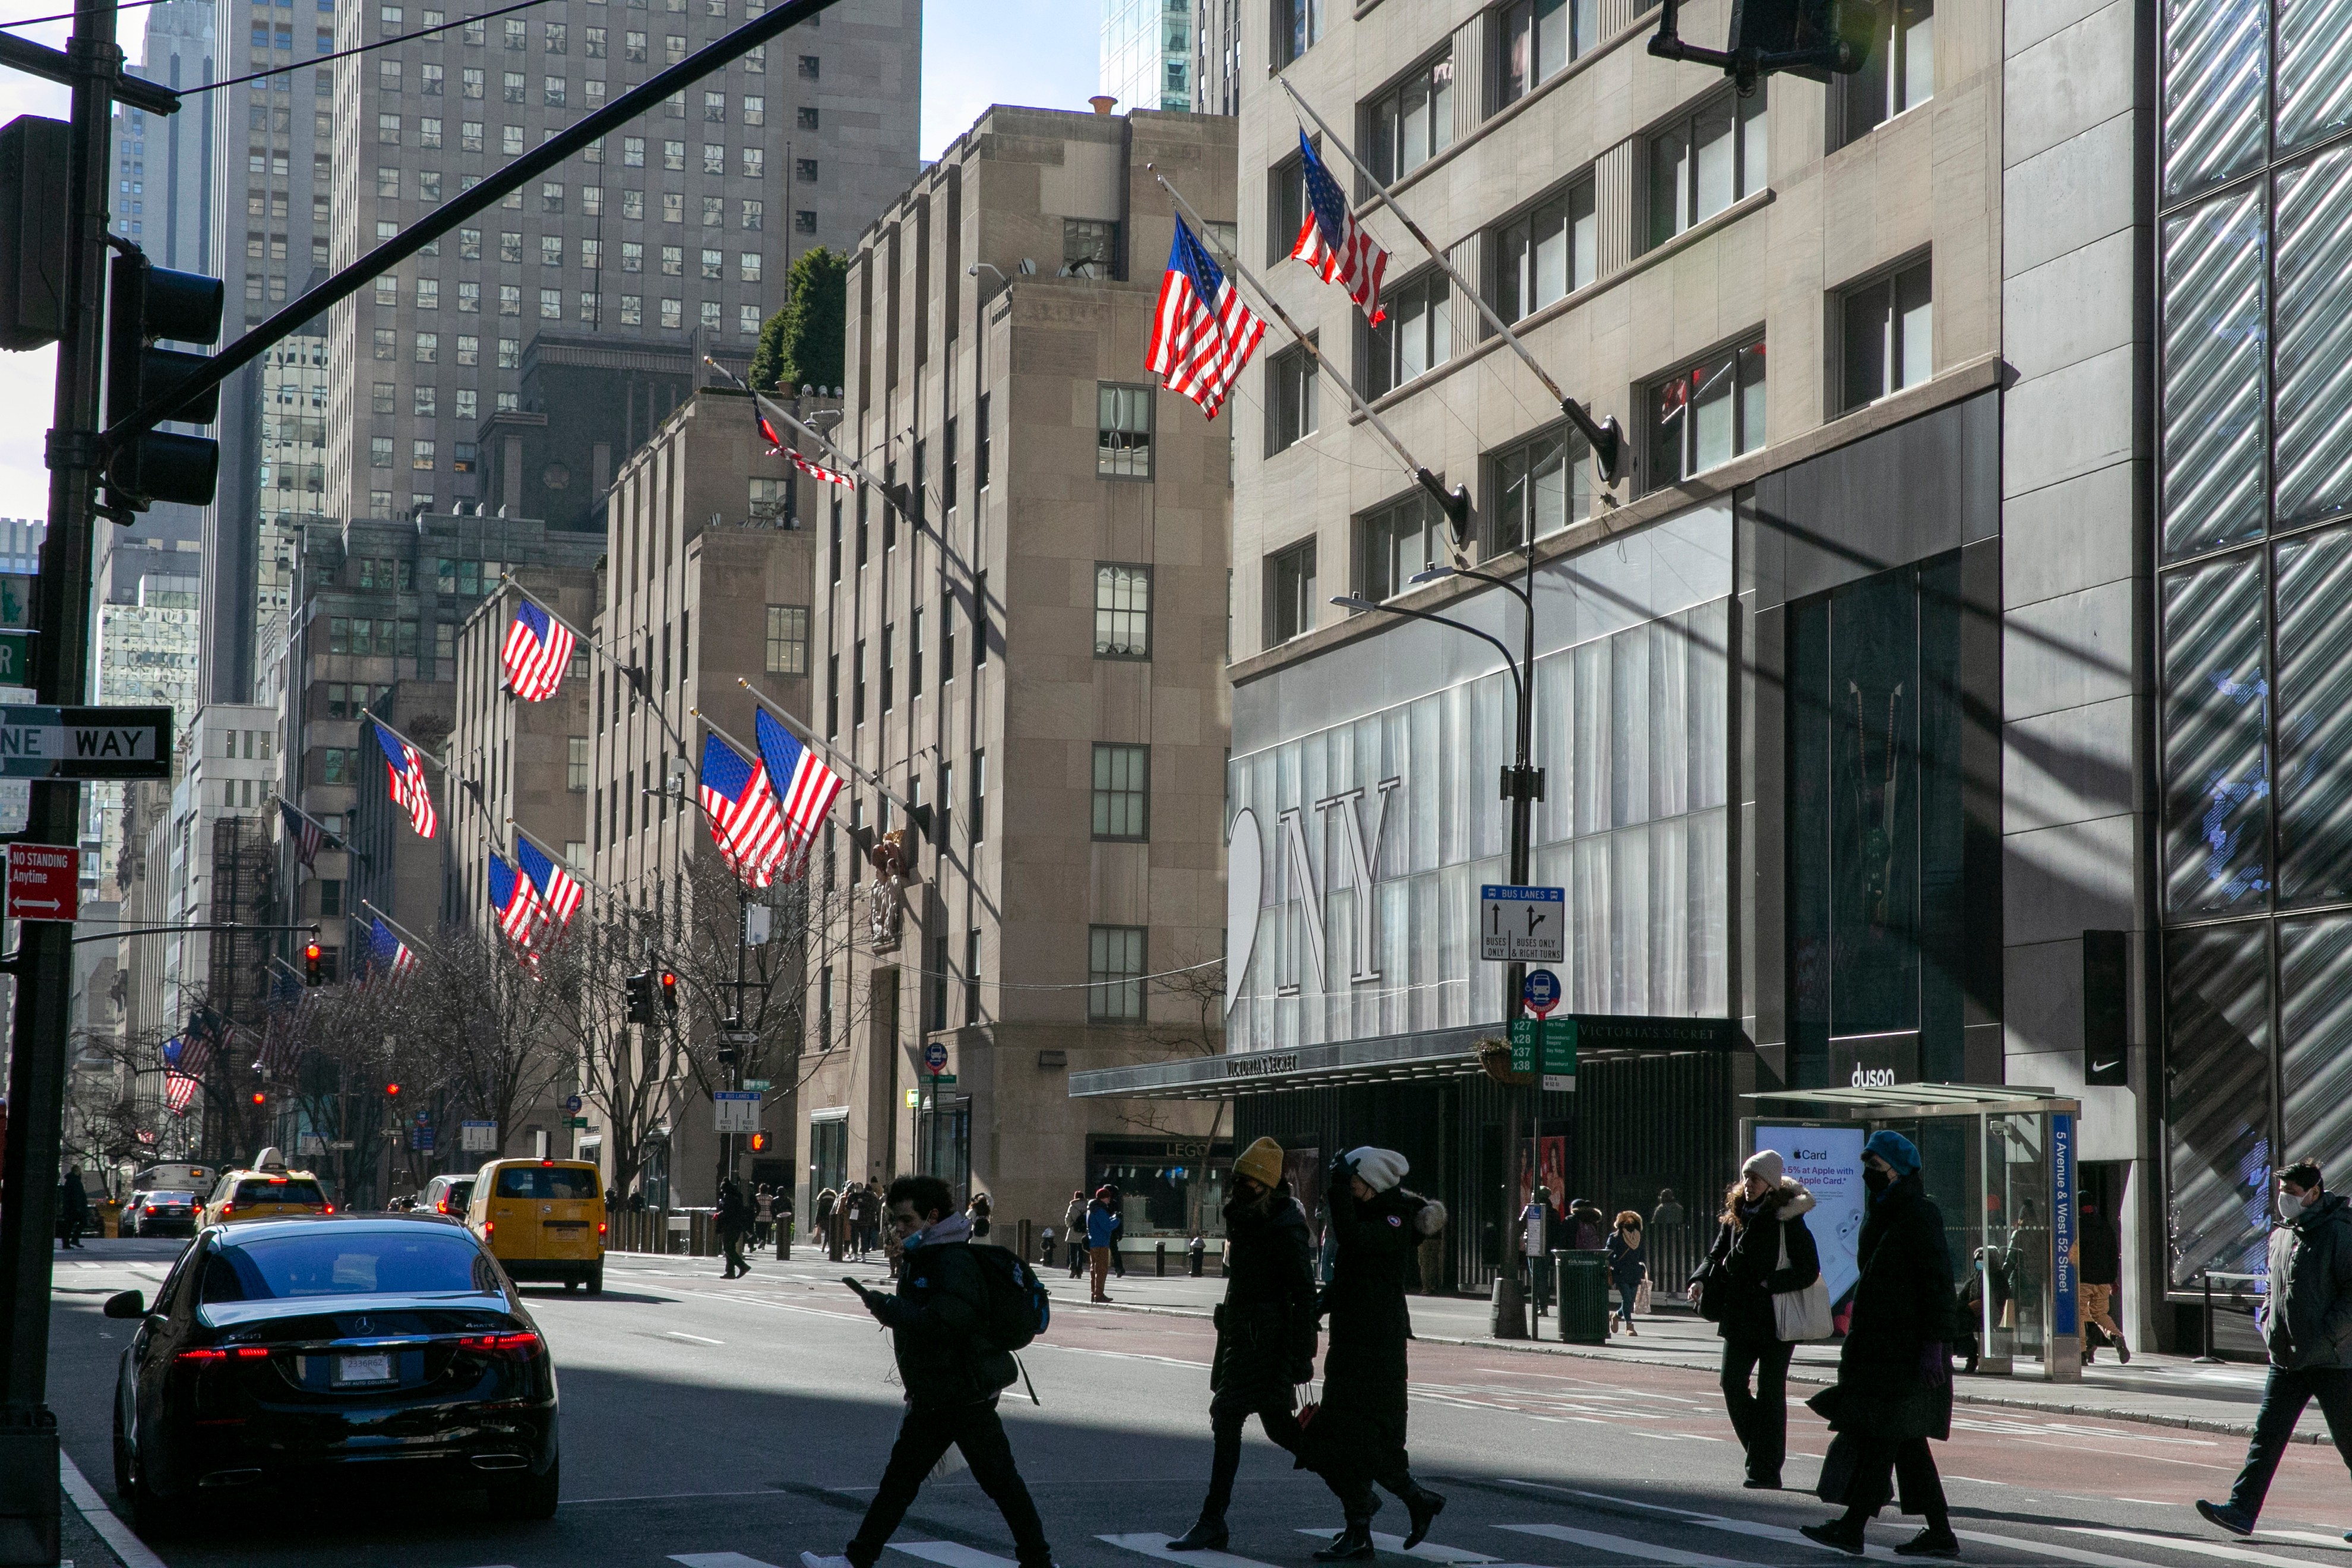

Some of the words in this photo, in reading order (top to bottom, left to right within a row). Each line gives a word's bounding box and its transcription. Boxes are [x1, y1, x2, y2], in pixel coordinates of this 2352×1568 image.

[75, 730, 143, 757] WAY
[13, 852, 25, 865] NO
[27, 852, 68, 868] STANDING
[13, 869, 48, 885] Anytime
[1501, 890, 1518, 899] BUS
[1520, 890, 1545, 899] LANES
[1486, 937, 1506, 946] BUSES
[1517, 938, 1537, 947] BUSES
[1488, 948, 1504, 956] ONLY
[1512, 949, 1517, 957] &
[1540, 950, 1560, 959] TURNS
[1533, 1001, 1556, 1011] STANDING
[1579, 1024, 1659, 1039] VICTORIA'S
[1664, 1027, 1715, 1039] SECRET
[1269, 1054, 1297, 1073] SECRET
[757, 1080, 763, 1089] 51
[1166, 1143, 1207, 1157] LEGO
[1802, 1149, 1827, 1160] Card
[2056, 1142, 2066, 1187] Avenue
[1812, 1166, 1835, 1175] Apple
[1798, 1177, 1821, 1185] Apple
[2057, 1191, 2068, 1200] &
[2057, 1203, 2068, 1234] West
[2058, 1238, 2068, 1252] 52
[2059, 1256, 2069, 1293] Street
[348, 1359, 382, 1368] 2336R62
